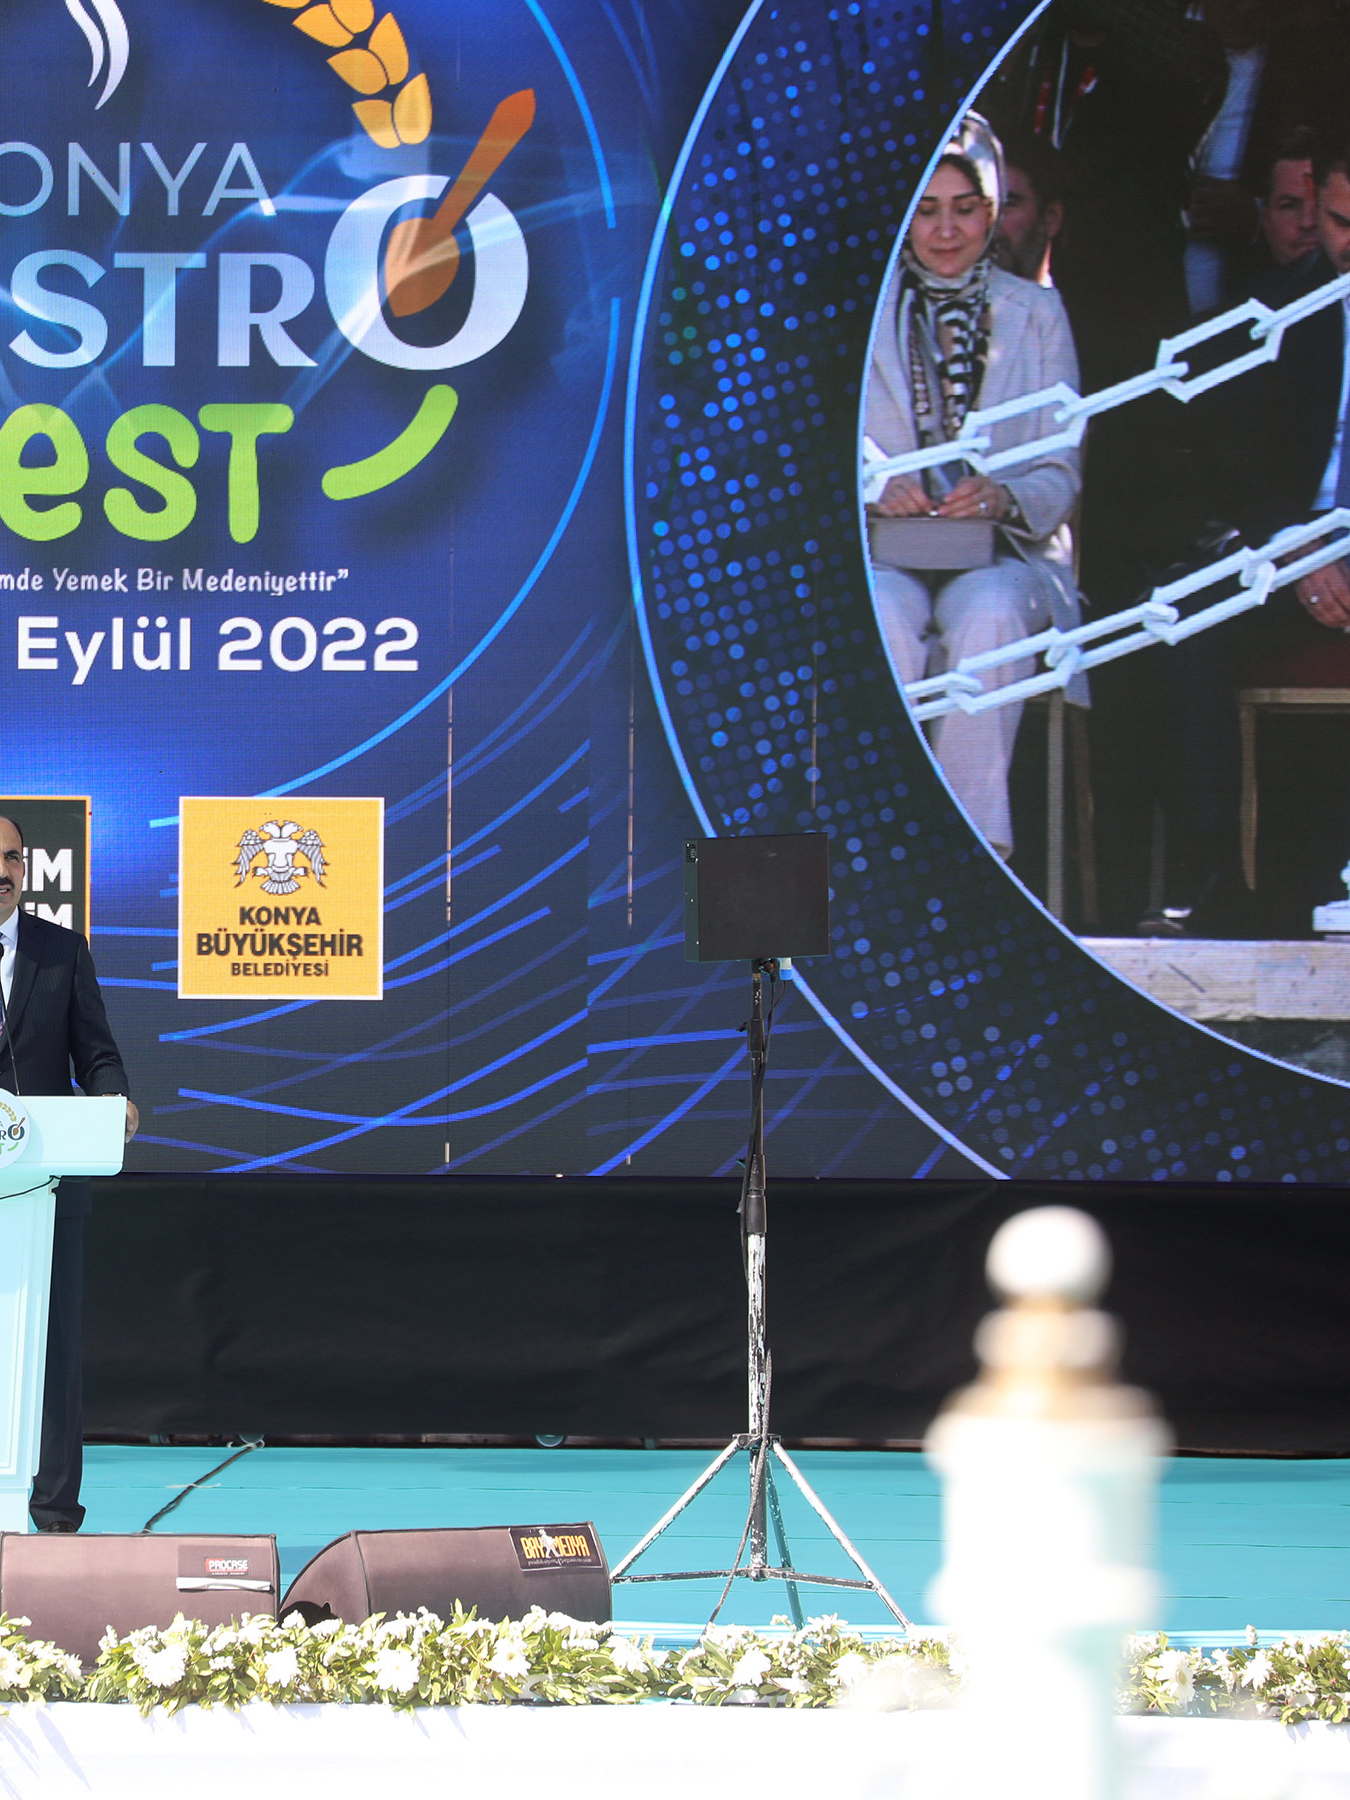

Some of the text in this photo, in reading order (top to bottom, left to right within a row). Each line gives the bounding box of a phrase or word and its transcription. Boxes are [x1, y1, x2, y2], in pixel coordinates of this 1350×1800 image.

[52, 566, 129, 592] Yemek
[136, 567, 174, 592] Bir
[17, 615, 192, 686] Eylül
[217, 616, 420, 673] 2022
[239, 906, 322, 926] KONYA
[196, 927, 364, 961] BÜYÜKŞEHİR
[230, 959, 329, 977] BELEDİYESİ
